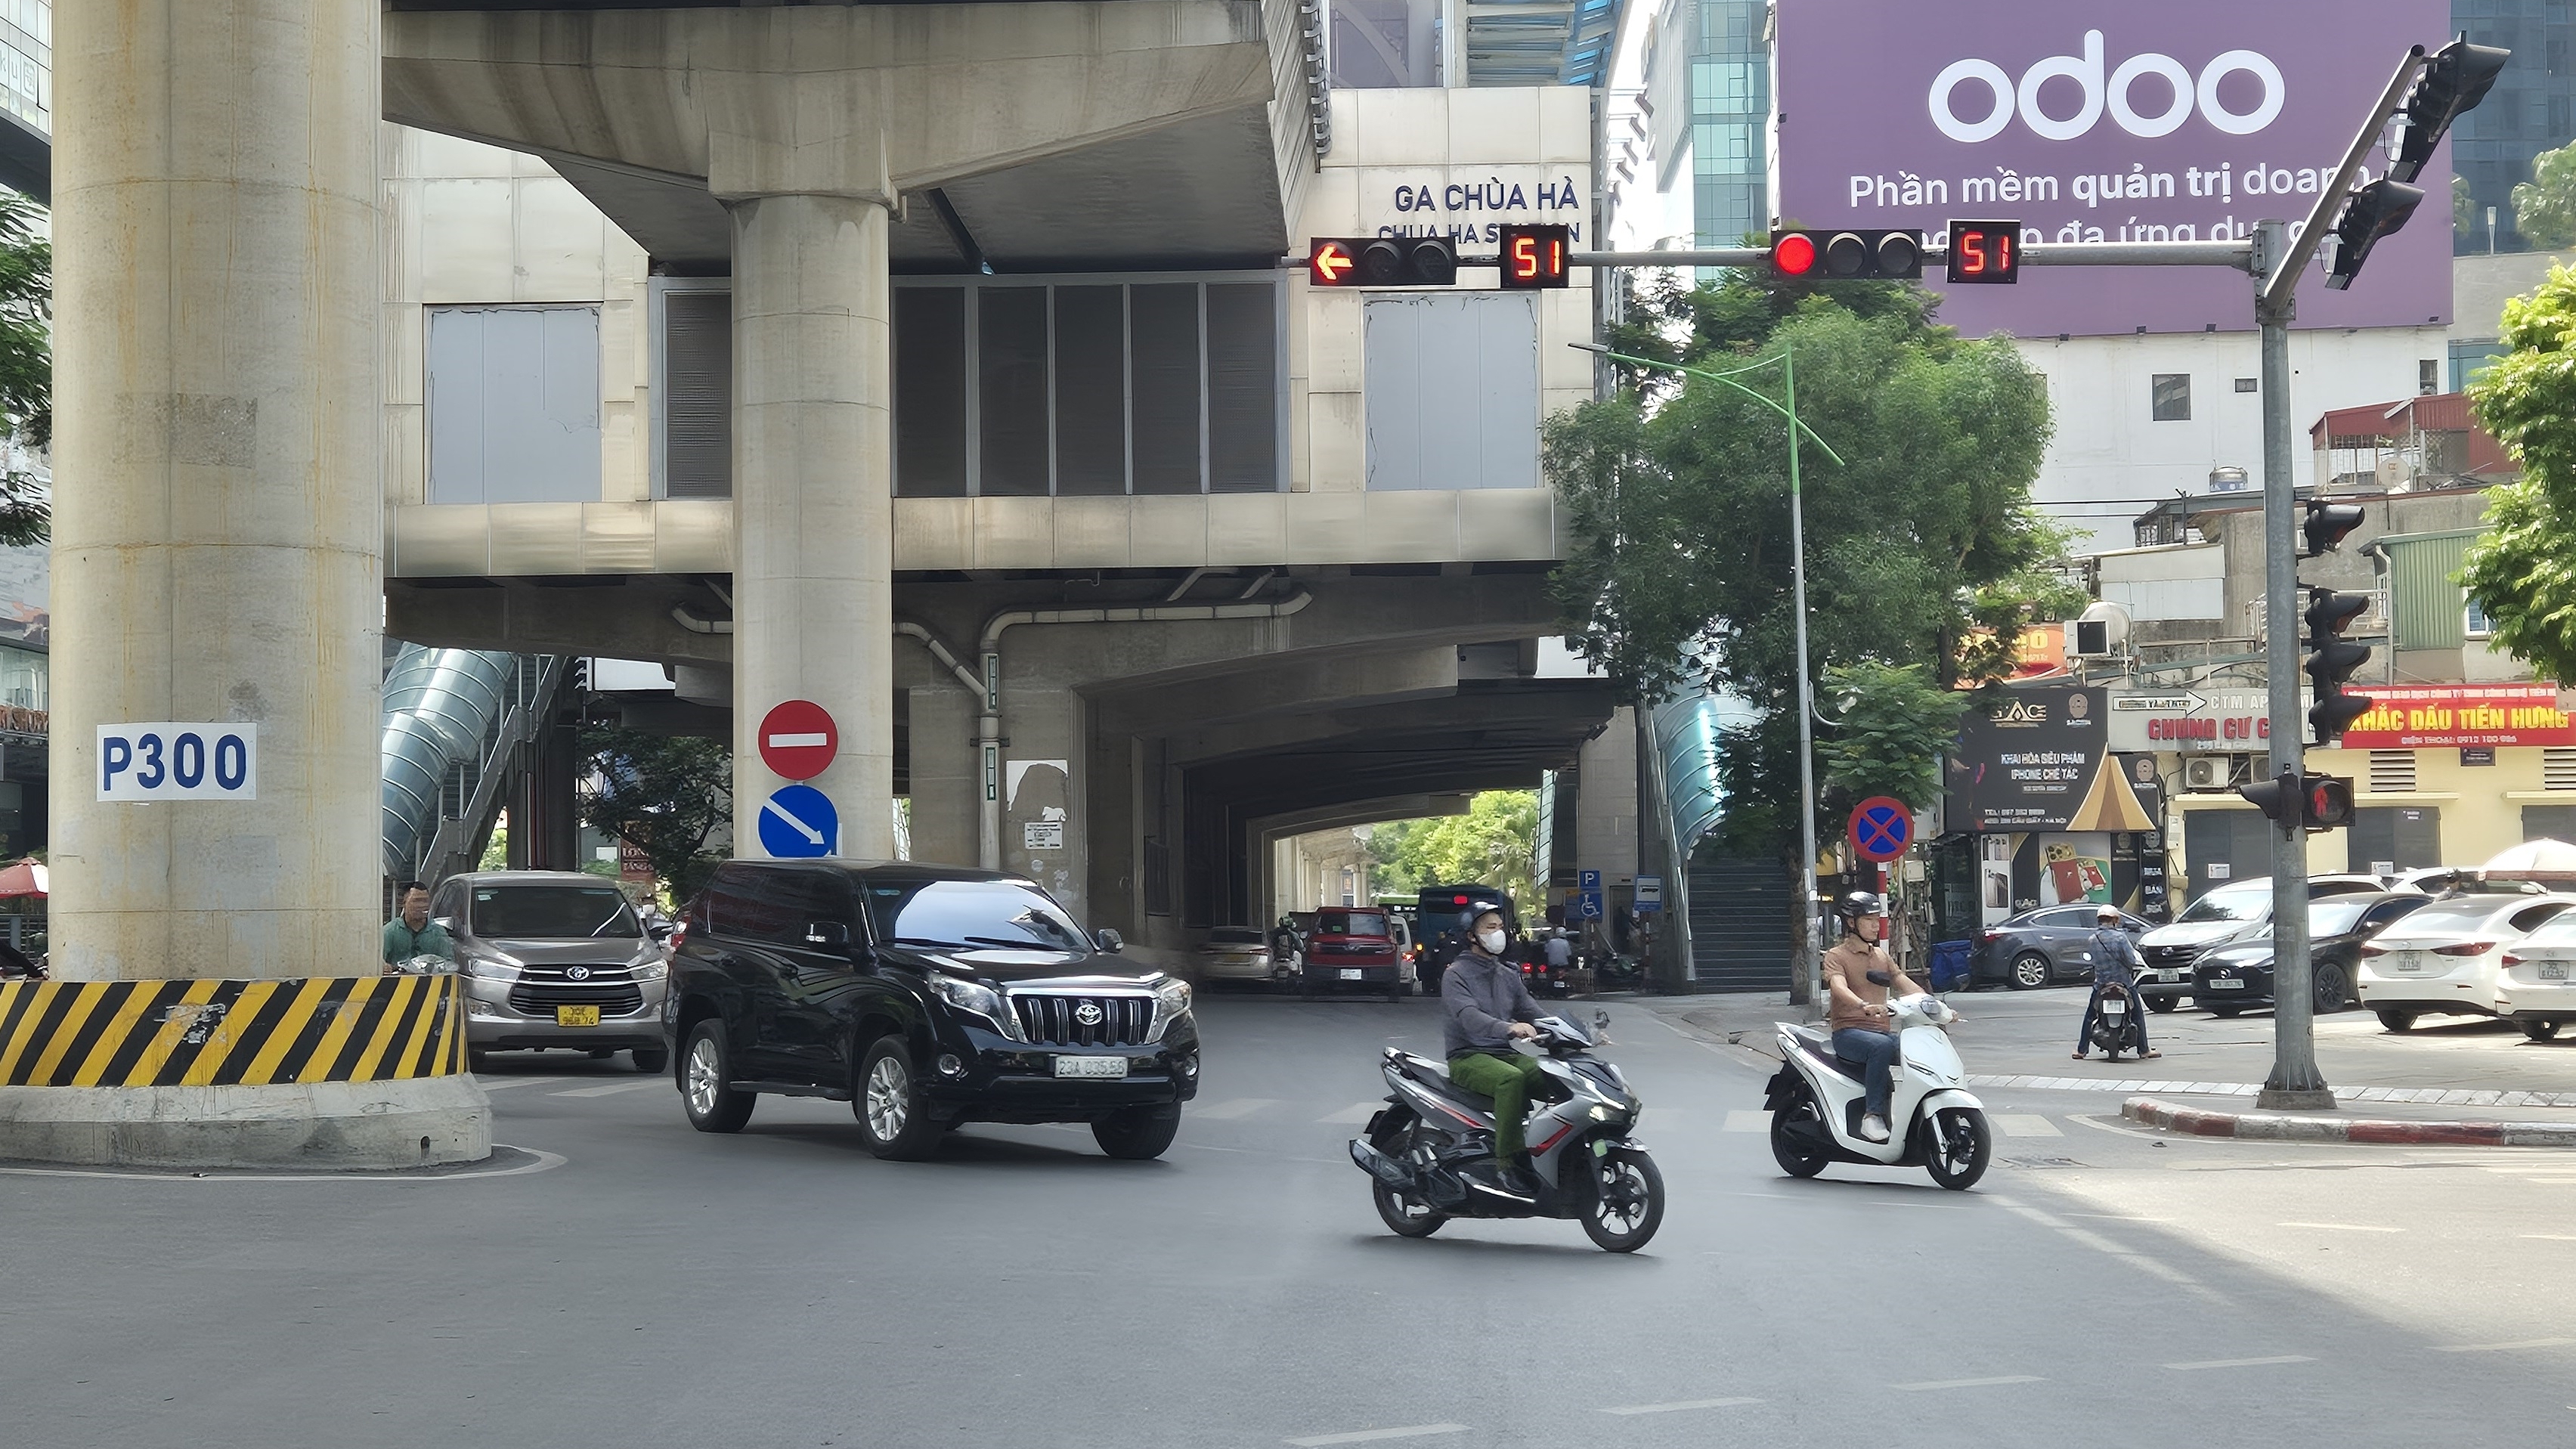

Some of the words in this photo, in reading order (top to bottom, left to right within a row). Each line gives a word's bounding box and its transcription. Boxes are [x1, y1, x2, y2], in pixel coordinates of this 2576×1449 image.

[1928, 29, 2286, 142] odoo
[1395, 185, 1435, 212] GA
[1444, 177, 1528, 211] CHÙA
[1537, 176, 1579, 210] HÀ
[1850, 170, 1948, 208] Phần
[1962, 166, 2058, 203] mềm
[2073, 163, 2175, 208] quản
[2186, 162, 2231, 203] trị
[2243, 162, 2371, 195] doan
[1448, 224, 1479, 244] HA
[1514, 237, 1561, 277] 51
[1962, 232, 2011, 273] 51
[2211, 694, 2243, 710] CTM
[2410, 702, 2452, 731] DẤU
[2458, 702, 2505, 730] TIẾN
[2148, 718, 2217, 740] CHUNG
[2224, 716, 2252, 740] CƯ
[103, 732, 247, 791] P300
[1584, 872, 1594, 884] P
